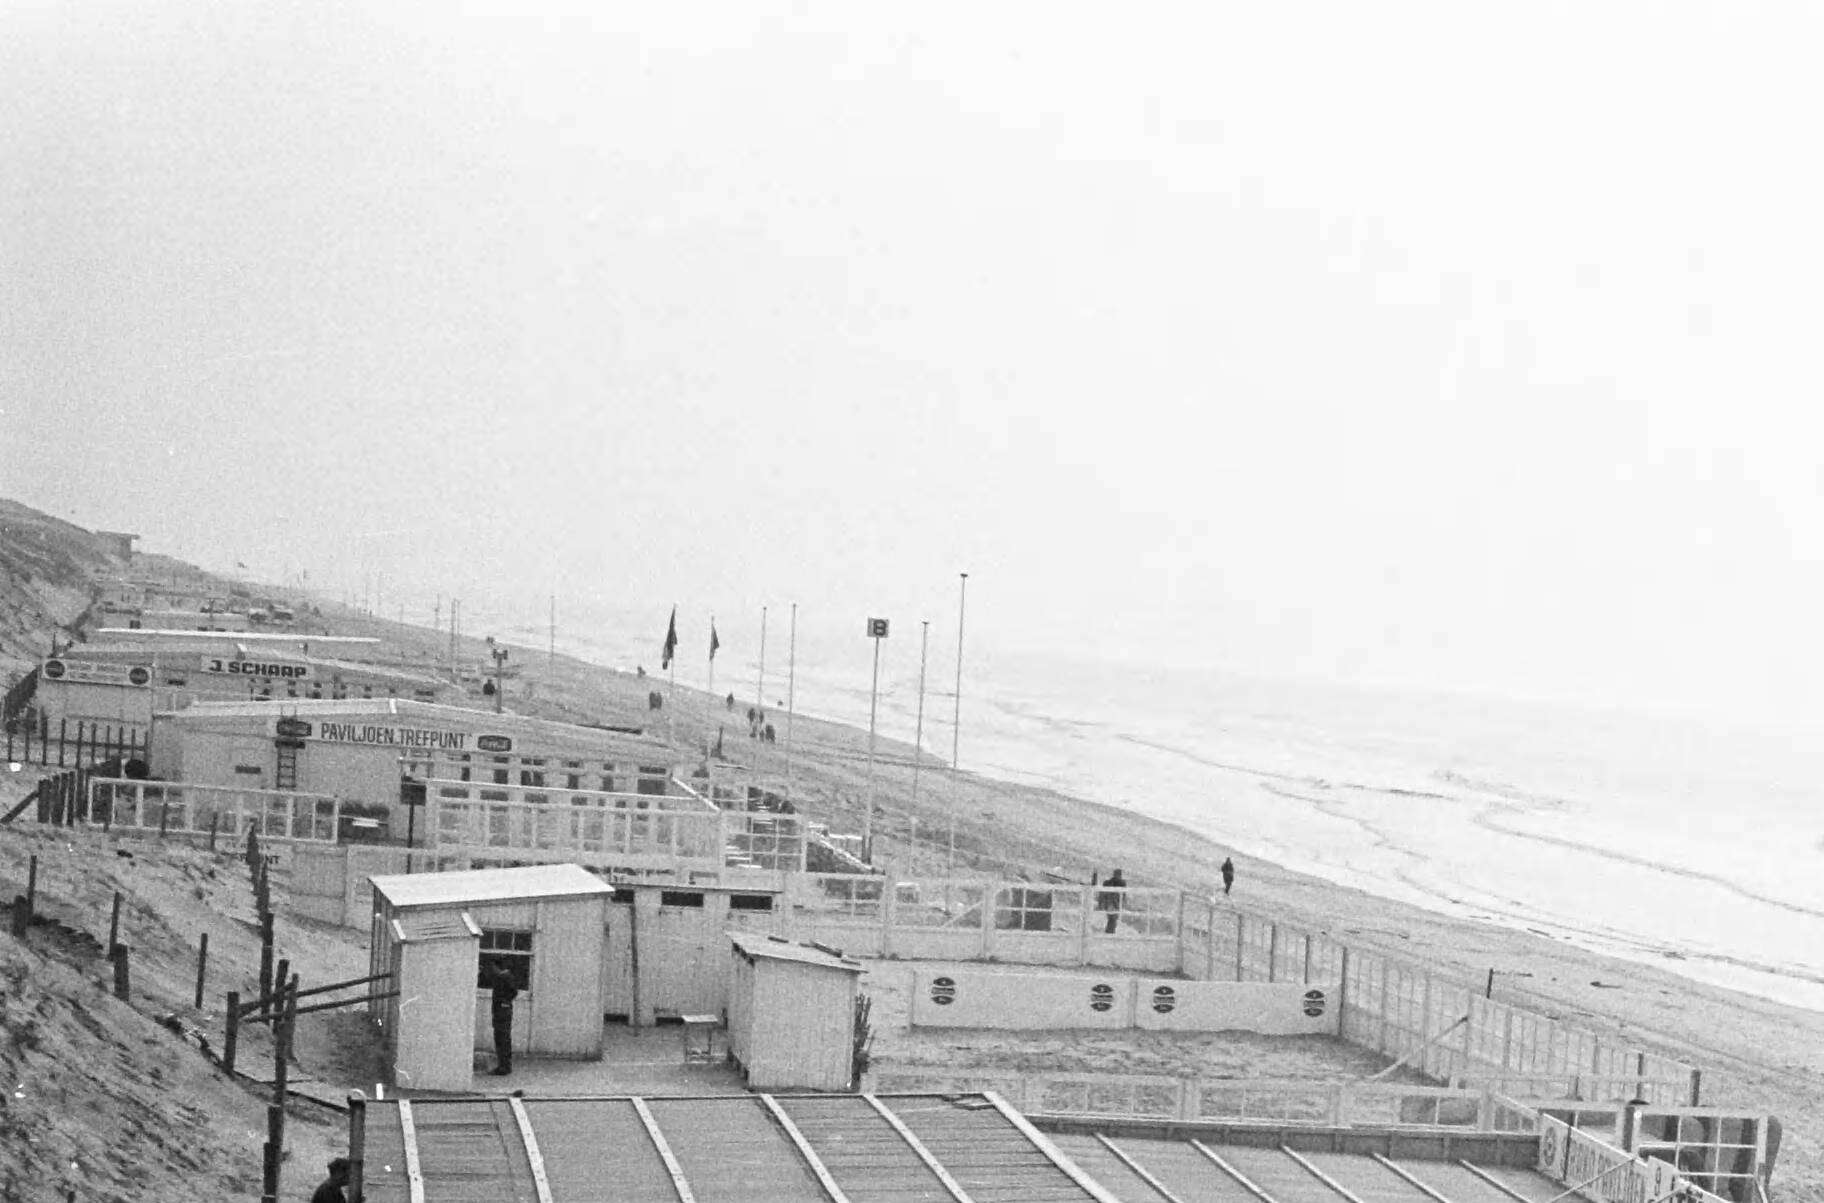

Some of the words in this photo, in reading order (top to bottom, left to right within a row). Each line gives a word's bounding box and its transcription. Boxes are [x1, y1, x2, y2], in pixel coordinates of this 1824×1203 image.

[228, 661, 306, 678] SCHAAP
[320, 723, 394, 745] PAVILJOEN
[399, 728, 465, 749] TREFPUNT
